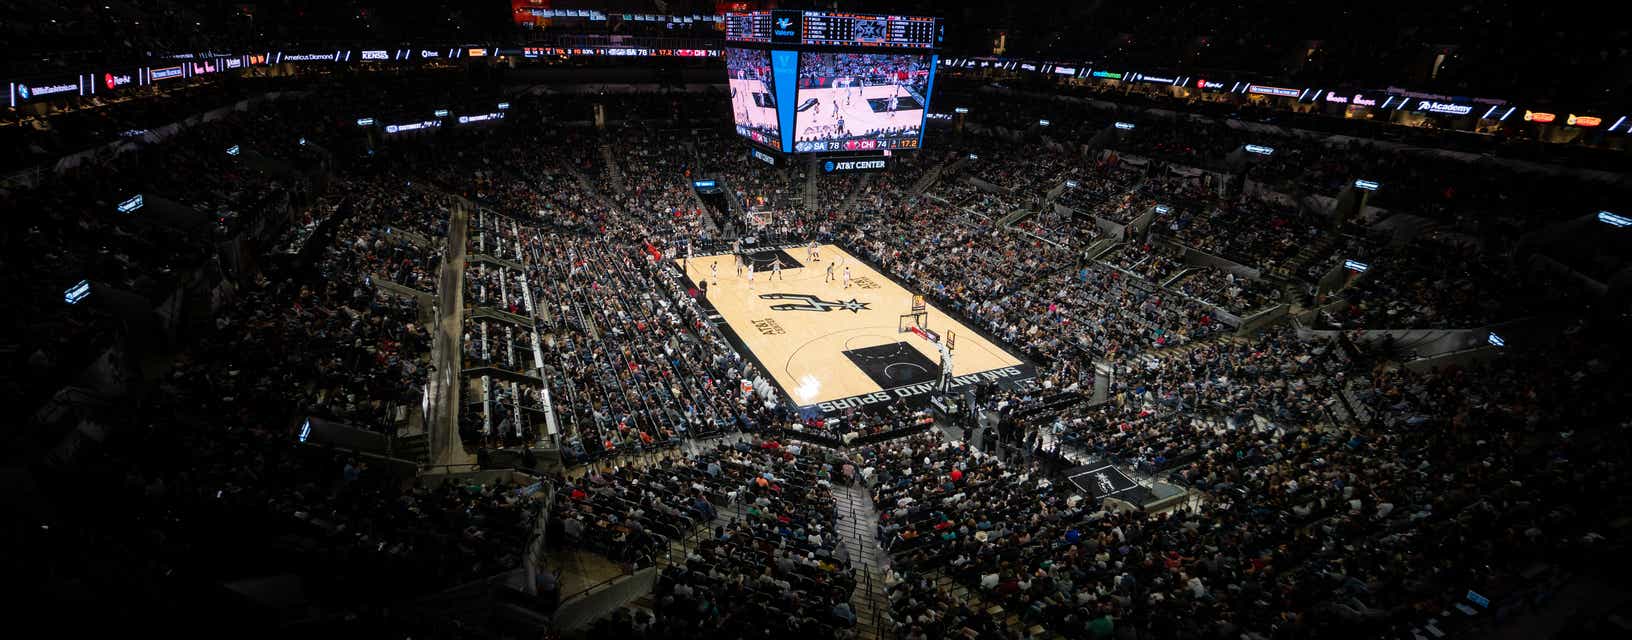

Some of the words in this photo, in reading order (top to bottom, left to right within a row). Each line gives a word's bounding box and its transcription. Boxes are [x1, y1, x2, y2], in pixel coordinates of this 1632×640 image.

[1430, 102, 1472, 112] Academy
[814, 142, 825, 150] SA
[861, 141, 874, 149] CHI
[877, 140, 887, 148] 74
[901, 140, 917, 148] 17.2
[835, 162, 857, 170] AT&T
[856, 161, 885, 169] CENTER
[895, 375, 980, 397] ANTNIO
[820, 391, 892, 412] SPURS
